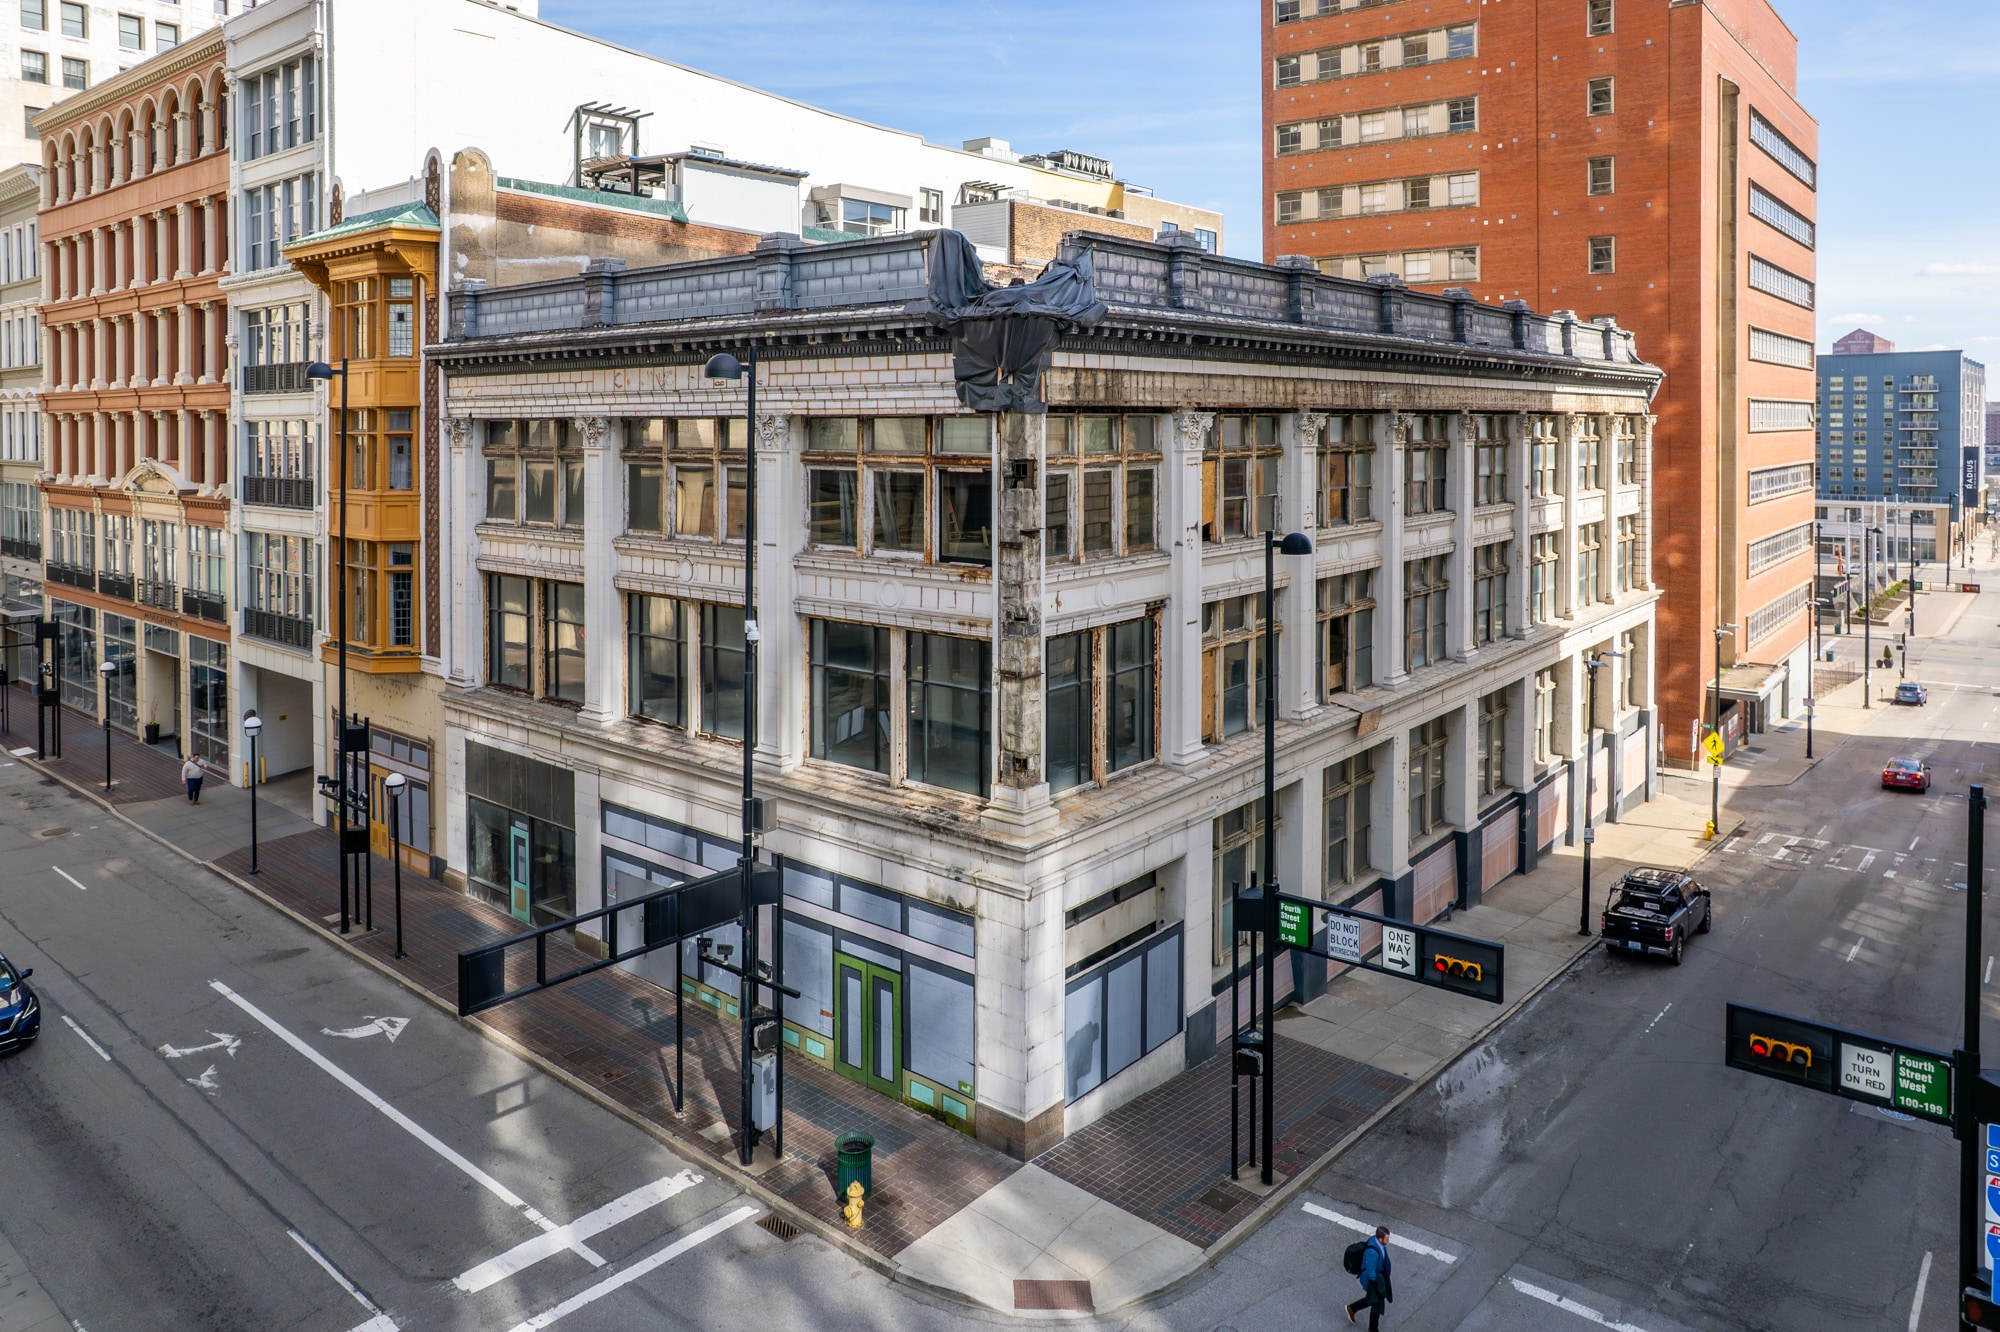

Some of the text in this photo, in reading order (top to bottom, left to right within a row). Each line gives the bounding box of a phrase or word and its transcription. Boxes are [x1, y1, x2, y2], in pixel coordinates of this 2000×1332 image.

[1280, 902, 1301, 914] Fourth
[1280, 911, 1300, 922] Street
[1280, 919, 1297, 930] West
[1330, 920, 1359, 935] DO NOT
[1281, 933, 1296, 943] 0-99
[1330, 933, 1359, 949] BLOCK
[1388, 931, 1410, 945] ONE
[1330, 946, 1359, 958] INTERSECTION
[1388, 942, 1411, 956] WAY
[1857, 1052, 1874, 1064] NO
[1899, 1055, 1935, 1073] Fourth
[1851, 1063, 1880, 1077] TURN
[1899, 1066, 1932, 1084] Street
[1845, 1073, 1885, 1091] ON RED
[1899, 1077, 1927, 1093] West
[1899, 1096, 1943, 1115] 100-199
